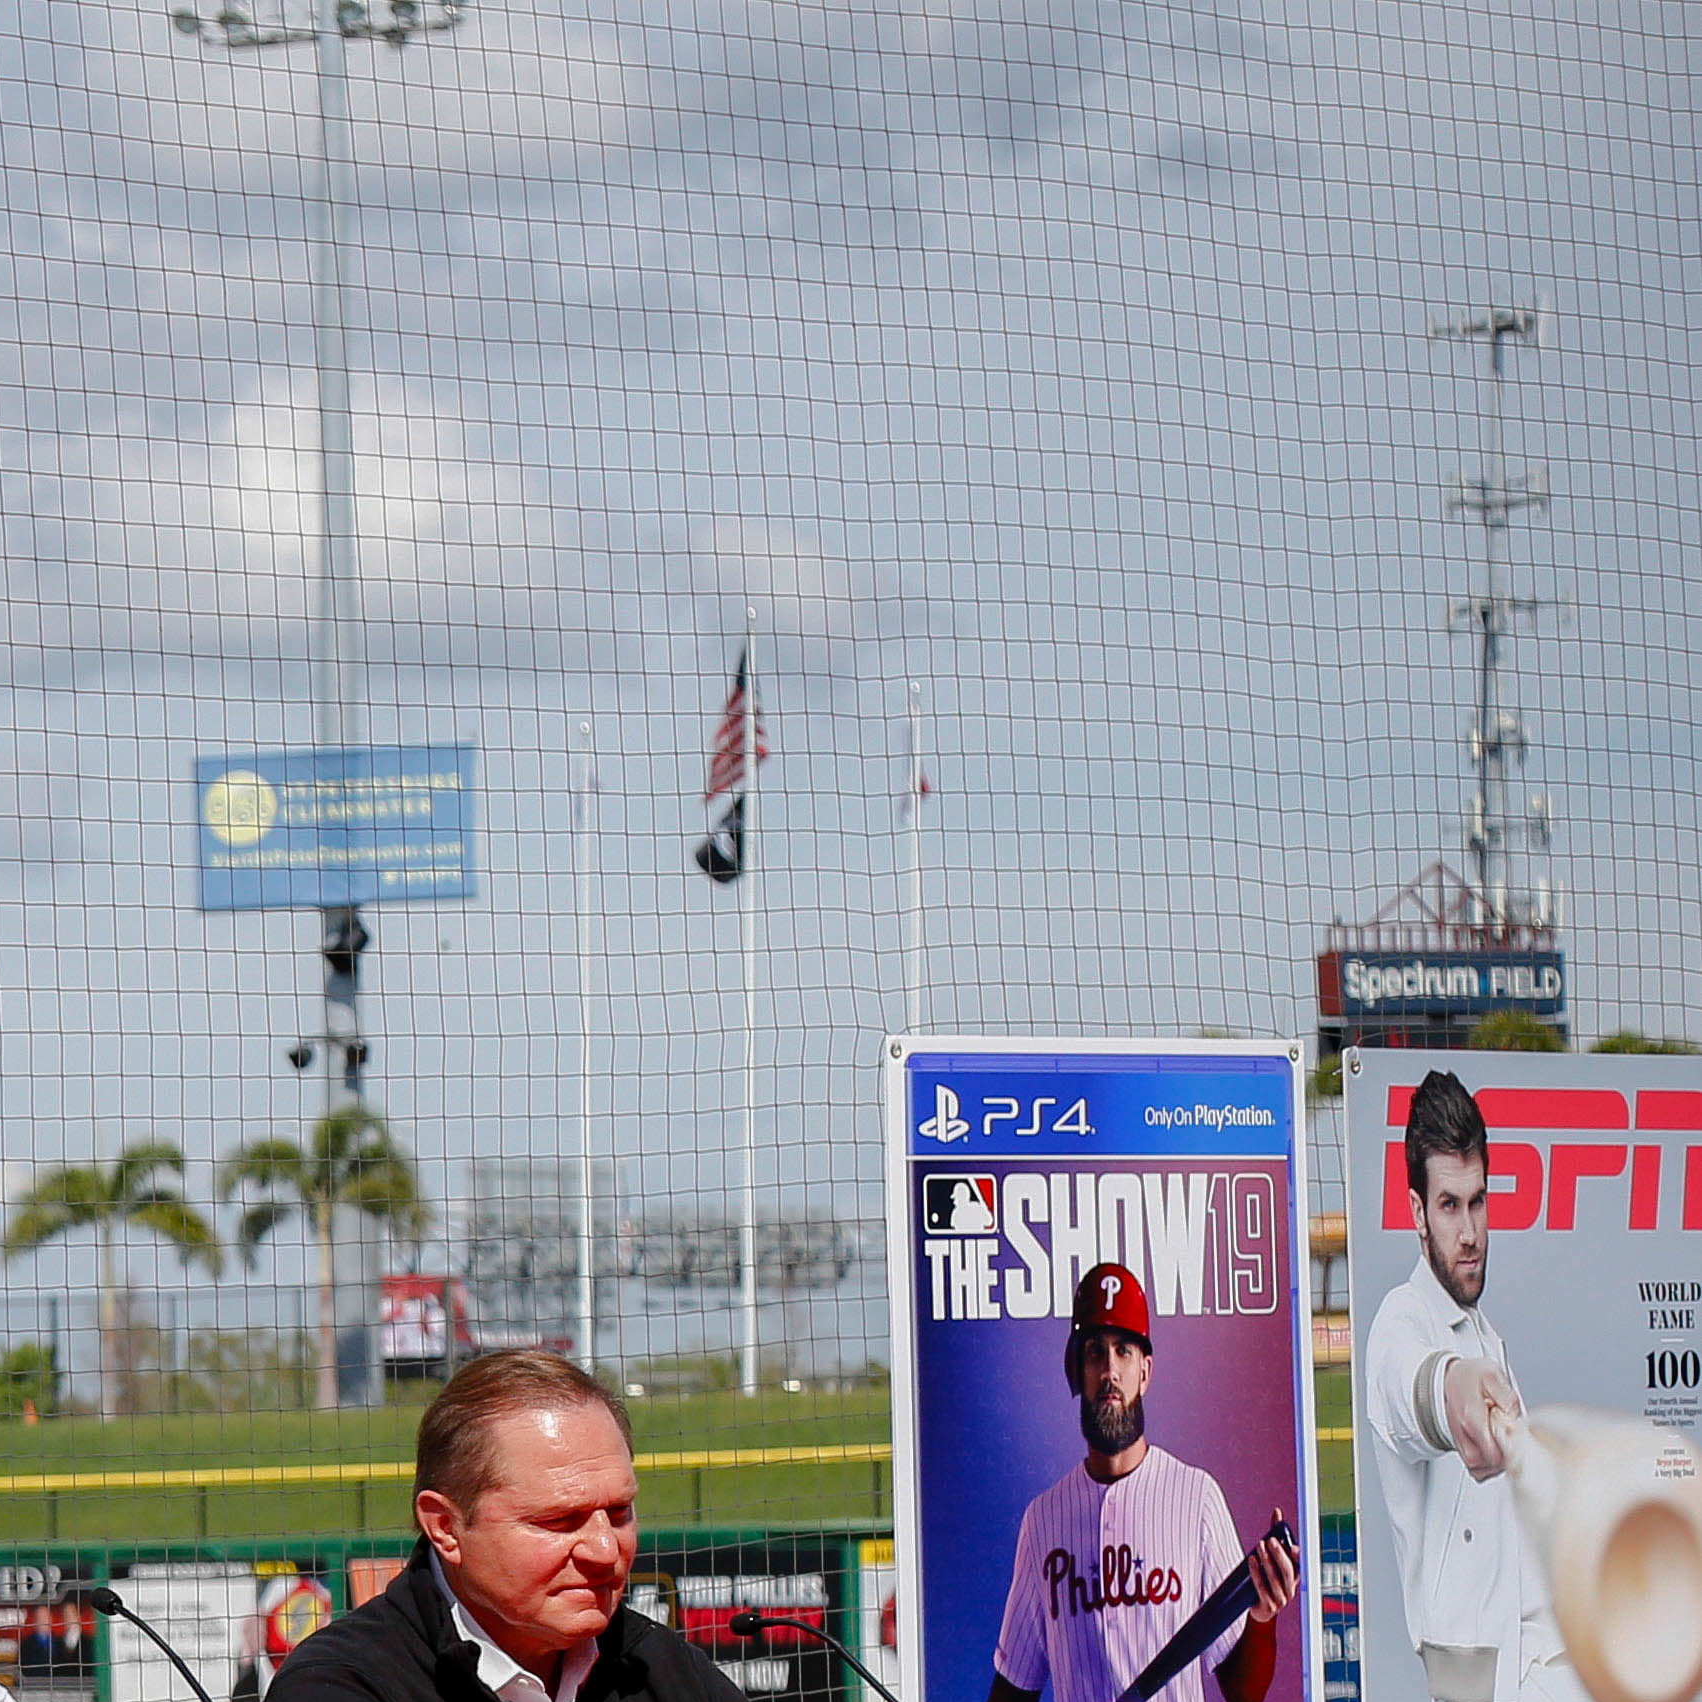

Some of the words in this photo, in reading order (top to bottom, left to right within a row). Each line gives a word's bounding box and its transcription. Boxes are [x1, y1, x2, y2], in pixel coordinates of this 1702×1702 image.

[1343, 958, 1480, 1008] Spectrum
[1490, 965, 1563, 999] FIELD
[982, 1096, 1092, 1136] PS4
[1145, 1106, 1173, 1130] Only
[1174, 1106, 1193, 1126] On
[924, 1238, 1001, 1320] THE
[1100, 1275, 1122, 1311] P
[1638, 1281, 1702, 1303] WORLD
[1649, 1309, 1695, 1330] FAME
[1646, 1349, 1701, 1389] 100
[1043, 1544, 1183, 1620] Phillies
